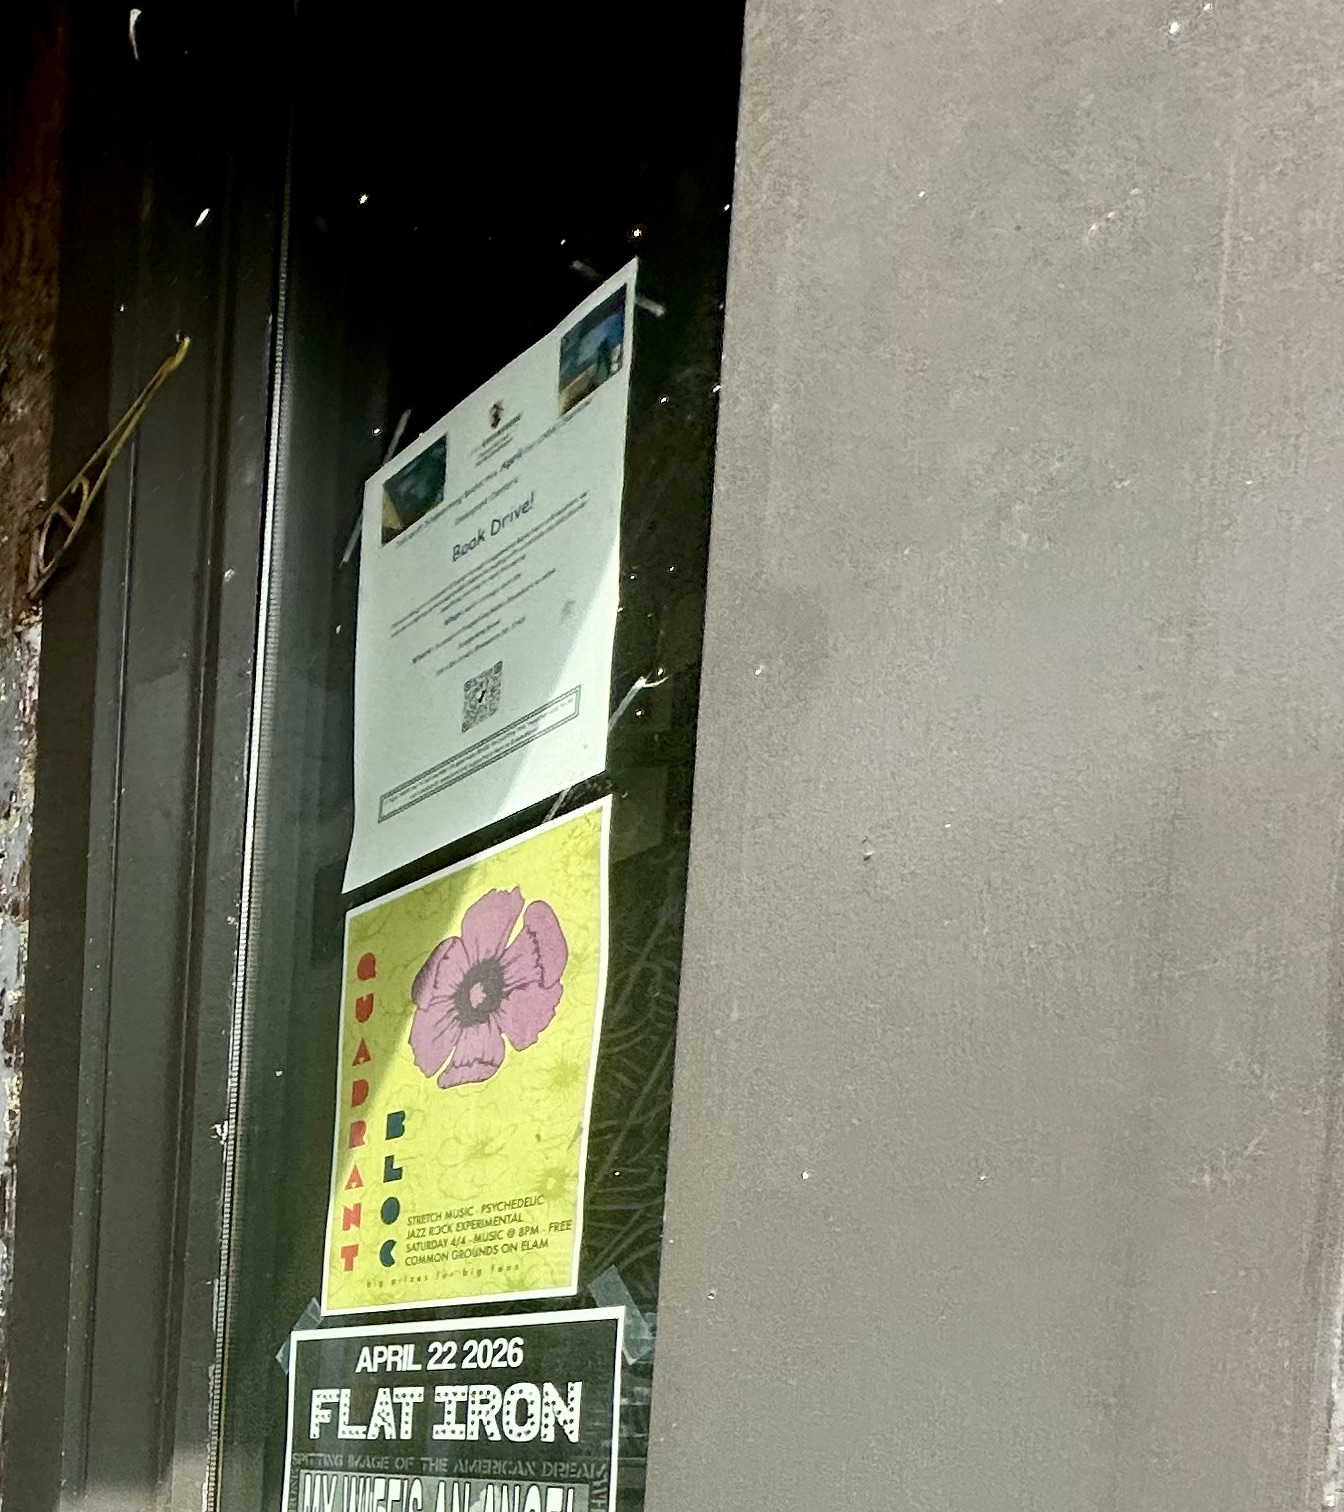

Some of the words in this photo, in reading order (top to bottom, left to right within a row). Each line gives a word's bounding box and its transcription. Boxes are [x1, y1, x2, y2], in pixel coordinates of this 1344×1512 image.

[452, 528, 486, 562] Book
[490, 490, 535, 537] Drive!
[406, 1228, 426, 1240] JAZZ
[456, 1212, 523, 1232] EXPERIMENTAL
[407, 1212, 442, 1226] STRETCH
[444, 1206, 474, 1219] MUSIC
[481, 1194, 545, 1214] PSYCHEDELIC
[404, 1252, 449, 1266] COMMON
[452, 1245, 498, 1260] GROUNDS
[501, 1242, 518, 1253] ON
[521, 1239, 549, 1251] ELAM
[406, 1238, 448, 1253] SATURDAY
[474, 1230, 504, 1243] MUSIC
[549, 1220, 572, 1233] FREE
[355, 1344, 422, 1373] APRIL
[426, 1341, 457, 1370] 22
[461, 1337, 524, 1369] 2026
[310, 1386, 424, 1439] FLAT
[432, 1381, 582, 1442] IRON
